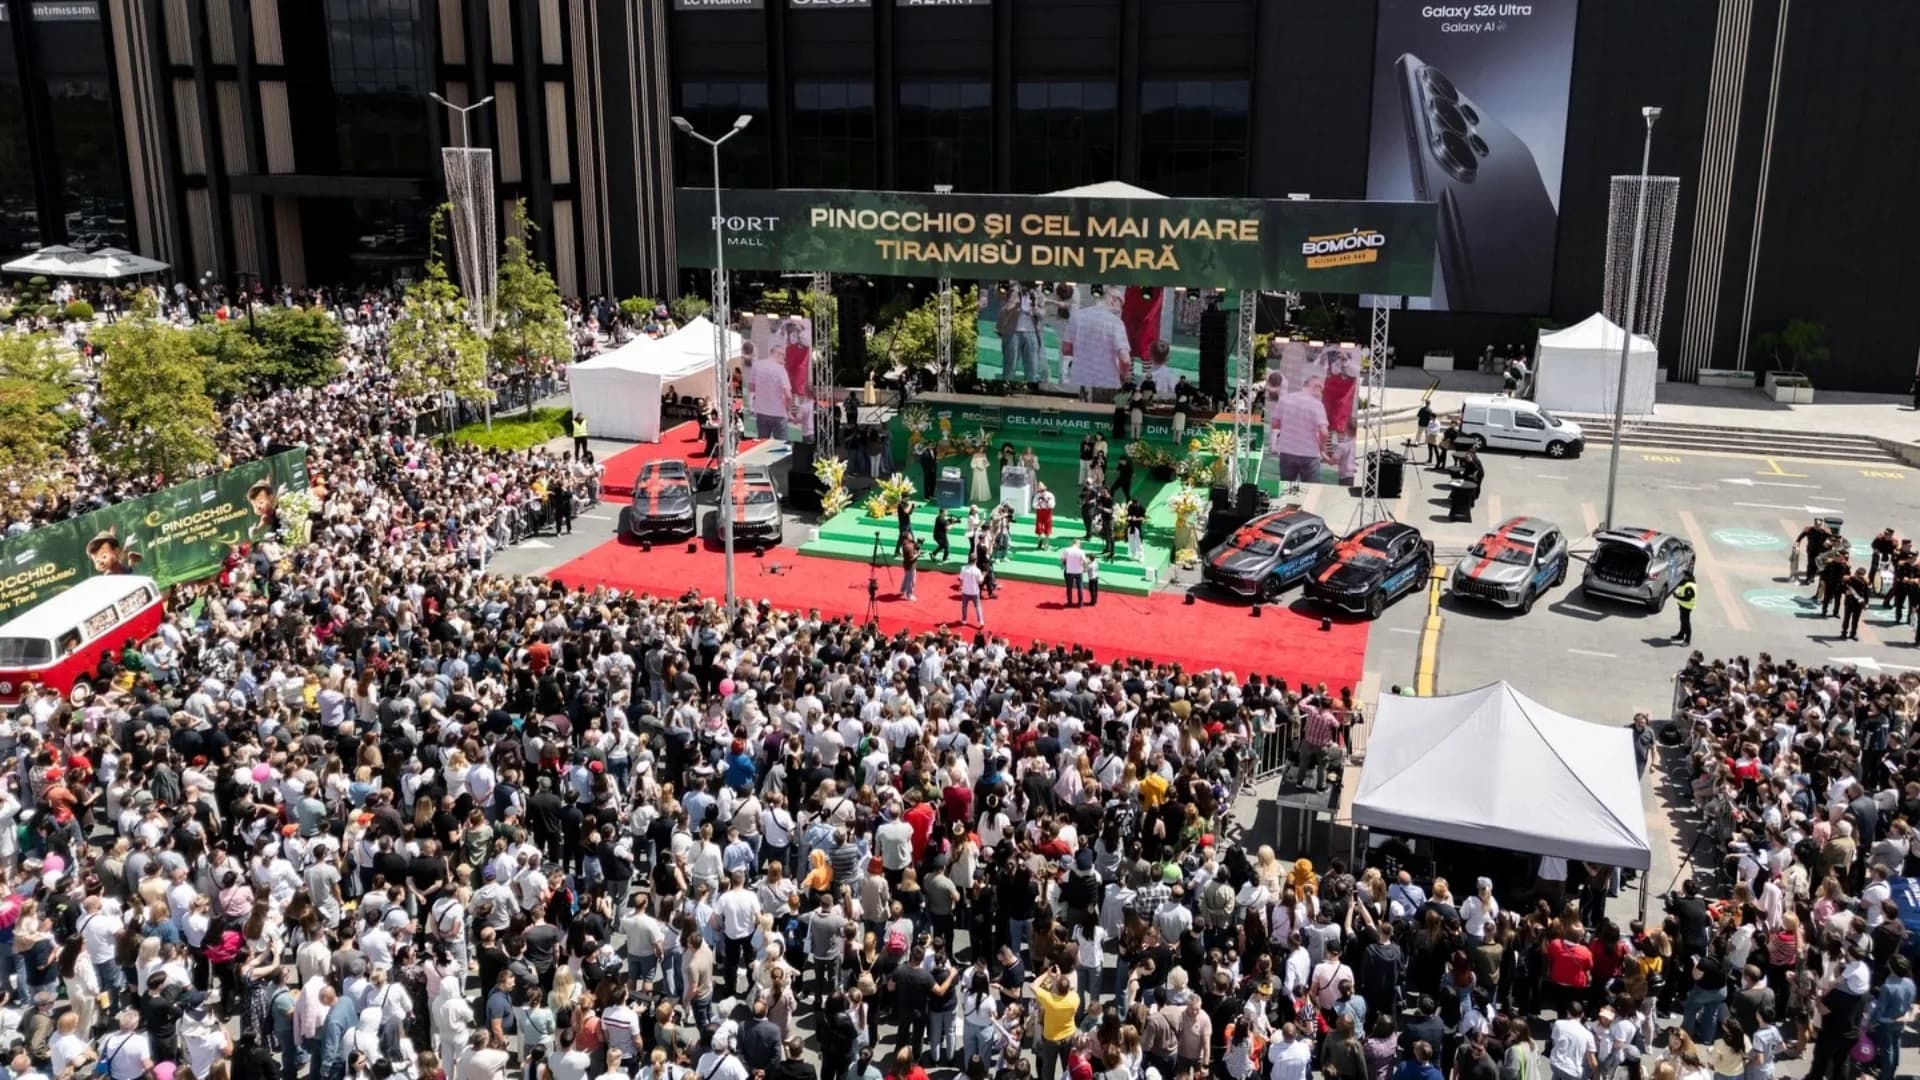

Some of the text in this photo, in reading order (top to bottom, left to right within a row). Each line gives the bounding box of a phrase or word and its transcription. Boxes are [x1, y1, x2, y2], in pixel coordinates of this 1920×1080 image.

[33, 6, 96, 16] intimissimi
[1422, 3, 1532, 20] Galaxy S26 Ultra
[1441, 22, 1495, 34] Galaxy AI
[711, 216, 780, 231] PORT
[810, 207, 1260, 241] PINOCCHIO ȘI CEL MAI MARE
[727, 237, 763, 246] MALL
[875, 239, 1180, 274] TIRAMISÙ DIN ȚARĂ
[1007, 415, 1030, 425] CEL
[1031, 416, 1053, 427] MAI
[1056, 418, 1090, 429] MARE
[1147, 425, 1168, 435] DIN
[161, 502, 233, 535] PINOCCHIO
